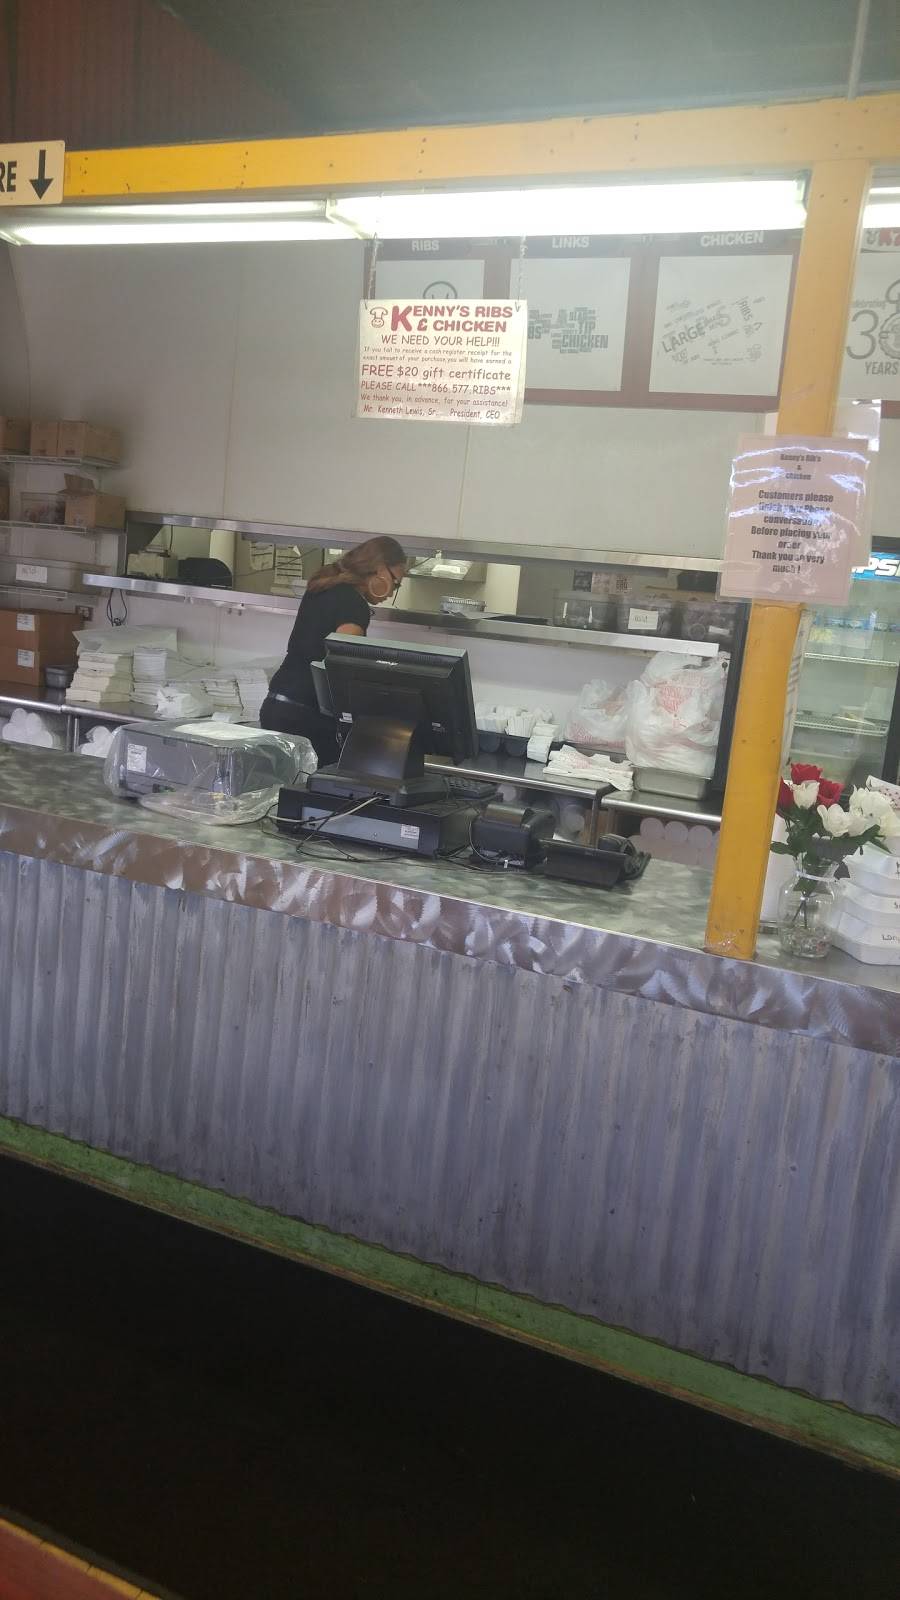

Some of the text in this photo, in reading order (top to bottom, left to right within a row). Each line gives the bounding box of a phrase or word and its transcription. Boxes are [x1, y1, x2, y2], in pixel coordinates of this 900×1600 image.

[412, 239, 440, 252] RIBS
[552, 235, 590, 249] LINKS
[700, 230, 764, 247] CHICKEN
[391, 305, 513, 332] KENNY'S RIBS
[417, 318, 507, 333] & CHICKEN
[381, 334, 500, 347] WE NEED YOUR HELP!!!
[562, 335, 609, 349] CHICKEN
[661, 322, 706, 353] LARGE
[468, 349, 488, 357] receipt
[361, 364, 511, 380] FREE $20 gift certificate
[865, 361, 899, 376] YEARS
[361, 381, 393, 391] PLEASE
[395, 382, 416, 392] CALL
[361, 393, 371, 401] We
[456, 398, 470, 406] your
[472, 398, 508, 407] assistance!
[378, 405, 402, 414] Kenneth
[485, 410, 500, 419] CEO
[758, 489, 834, 502] Customers please
[751, 525, 778, 536] Before
[780, 528, 811, 539] placing
[752, 550, 777, 560] Thank
[778, 553, 793, 562] you
[806, 554, 825, 564] very
